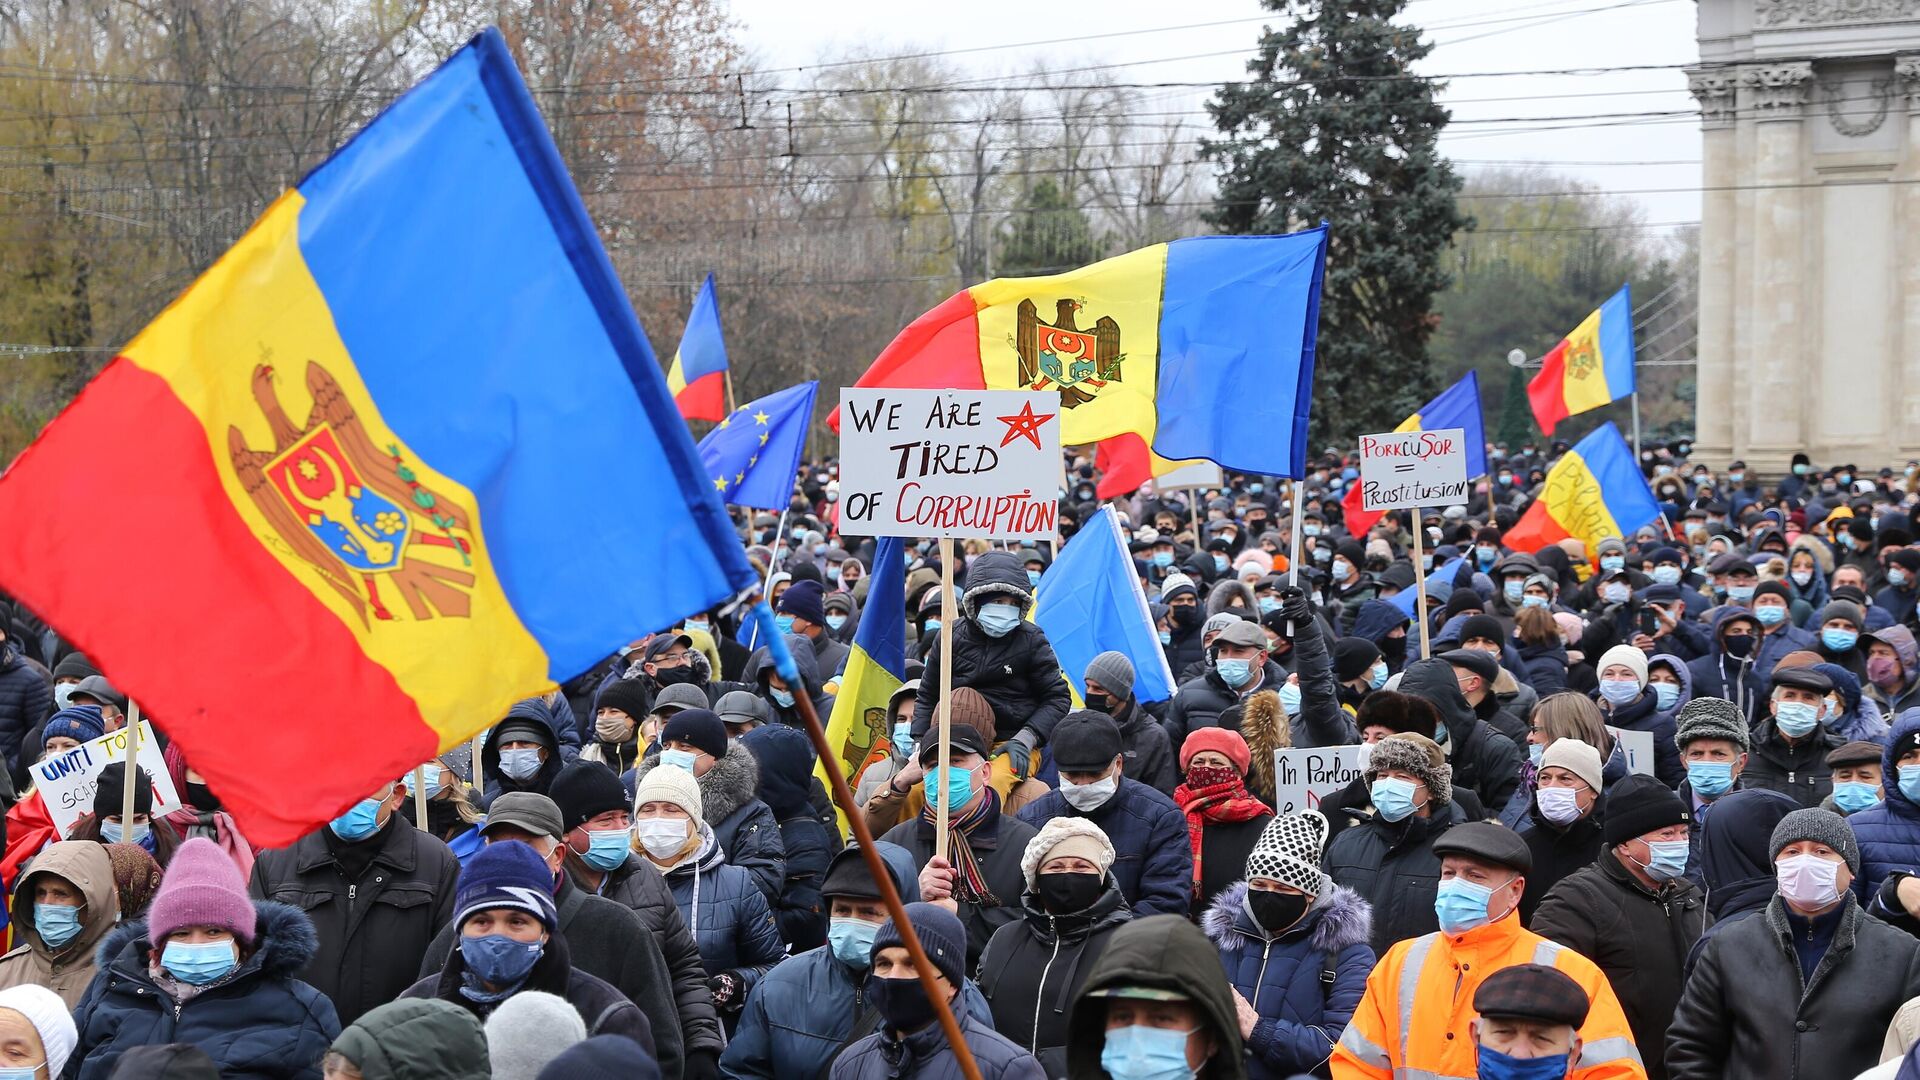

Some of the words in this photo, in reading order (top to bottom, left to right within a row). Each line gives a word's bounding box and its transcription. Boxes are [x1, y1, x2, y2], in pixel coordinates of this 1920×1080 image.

[848, 398, 902, 433] WE
[925, 396, 982, 429] ARE
[846, 491, 883, 521] OF
[98, 724, 145, 757] TOI
[1278, 755, 1297, 785] În
